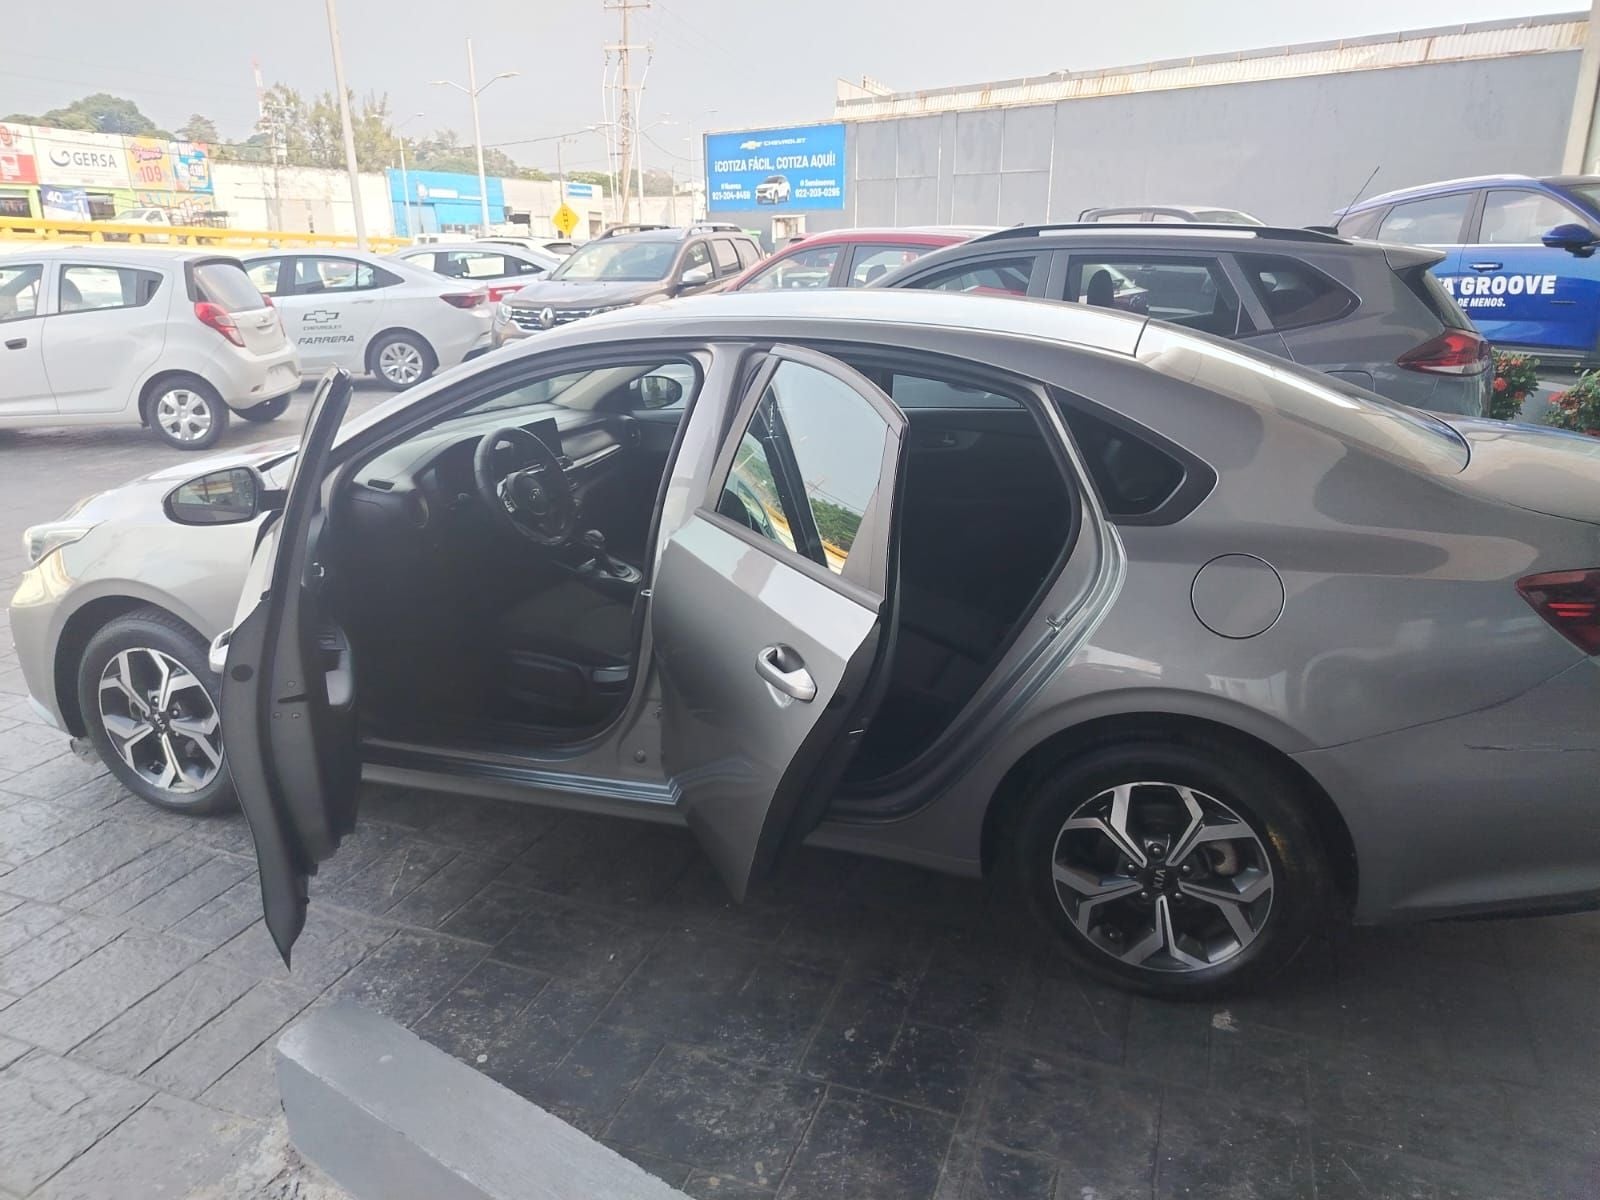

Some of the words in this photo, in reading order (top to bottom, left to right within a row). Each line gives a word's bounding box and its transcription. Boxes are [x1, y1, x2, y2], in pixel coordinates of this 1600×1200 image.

[763, 138, 807, 147] CHEVROLET
[72, 152, 118, 169] GERSA
[715, 159, 747, 173] ¡COTIZA
[748, 156, 775, 171] FÁCIL,
[776, 155, 809, 170] COTIZA
[810, 151, 836, 168] AQUÍ!
[140, 166, 163, 183] 109
[1460, 274, 1557, 295] GROOVE
[1469, 297, 1506, 307] MENOS.
[298, 335, 355, 345] FARRERA
